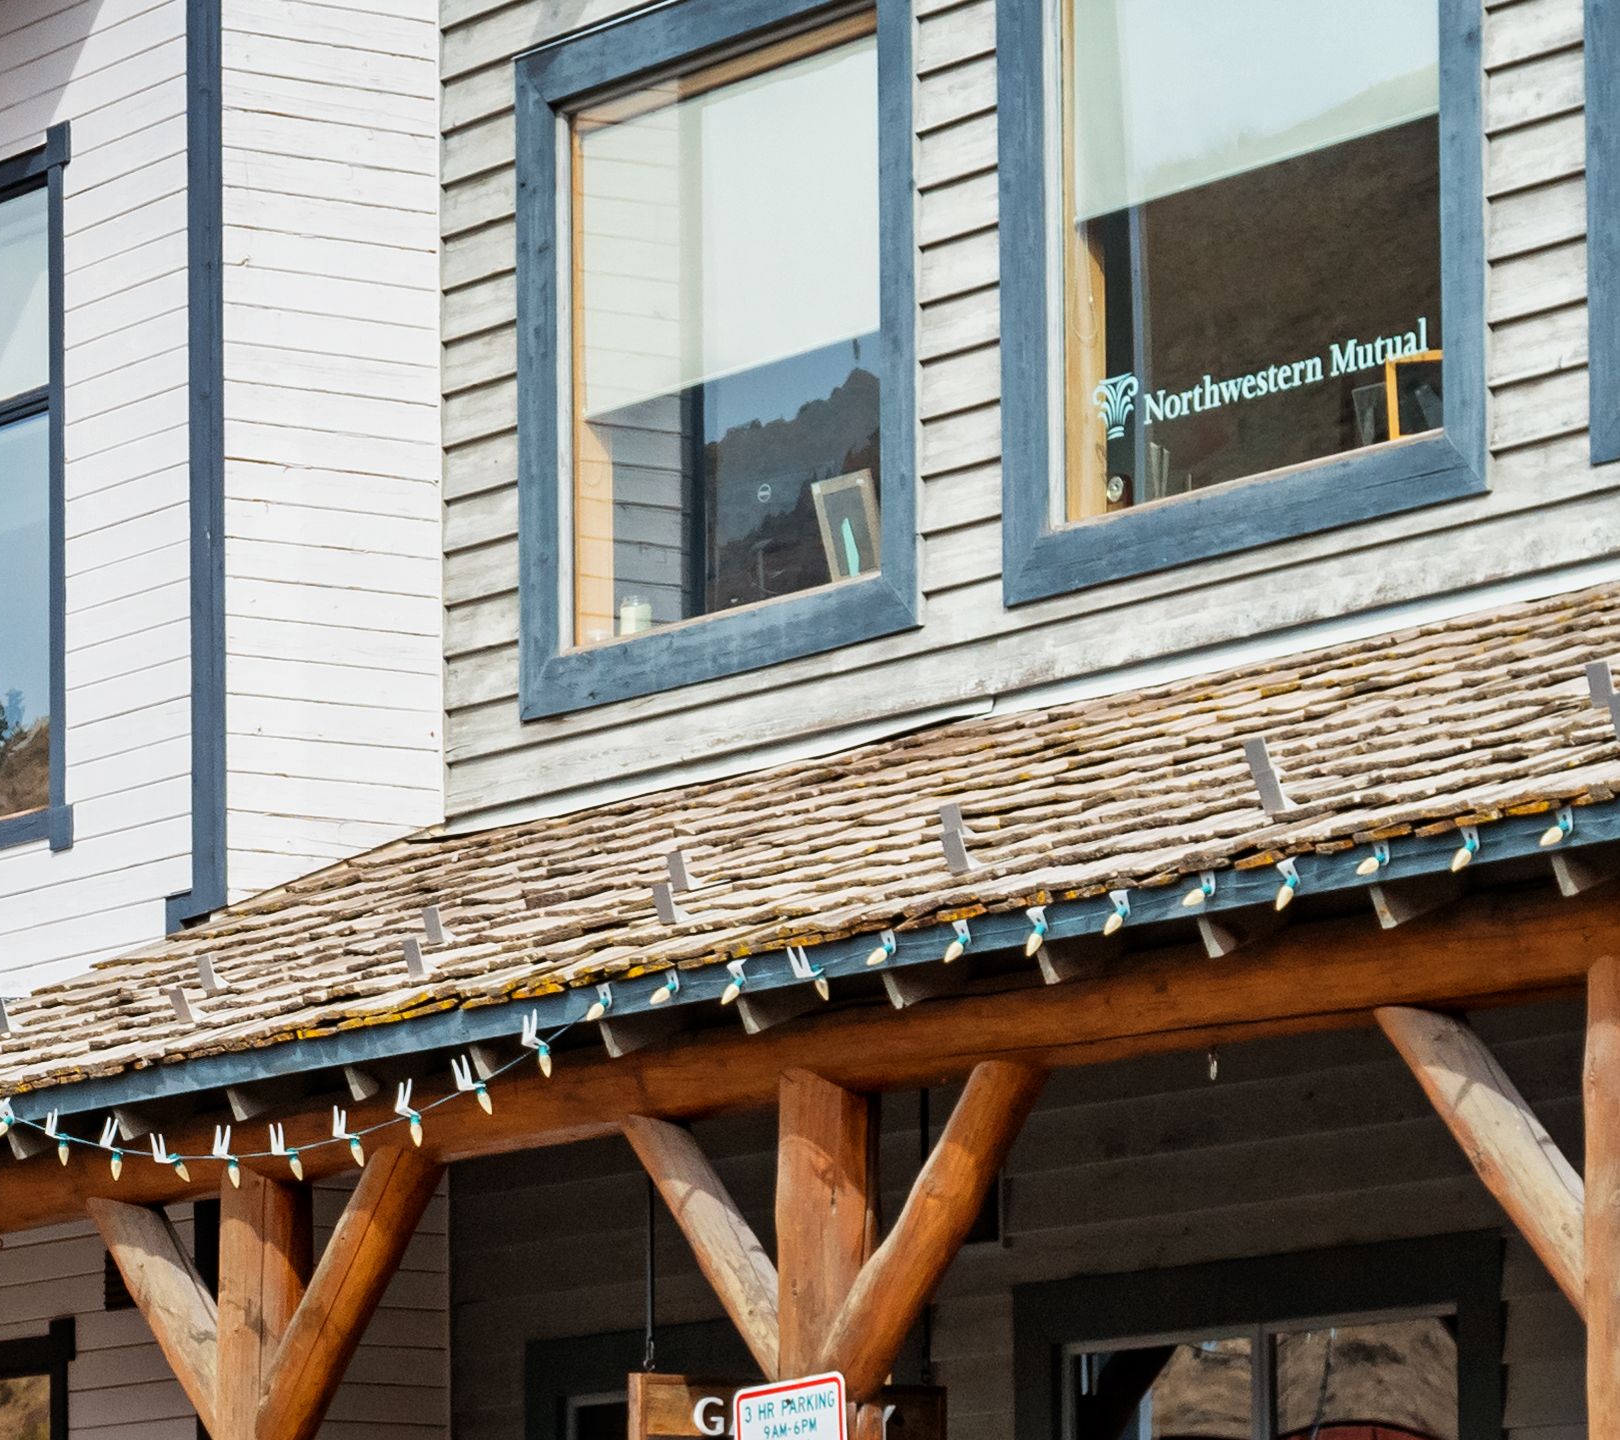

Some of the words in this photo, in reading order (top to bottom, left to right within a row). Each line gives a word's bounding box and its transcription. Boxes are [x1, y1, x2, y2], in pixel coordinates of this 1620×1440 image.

[1143, 354, 1324, 426] Northwestern
[1329, 316, 1430, 377] Mutual
[744, 1406, 753, 1424] 3
[758, 1400, 775, 1420] HR
[781, 1390, 836, 1418] PARKING
[763, 1417, 818, 1440] 9AM-6PM
